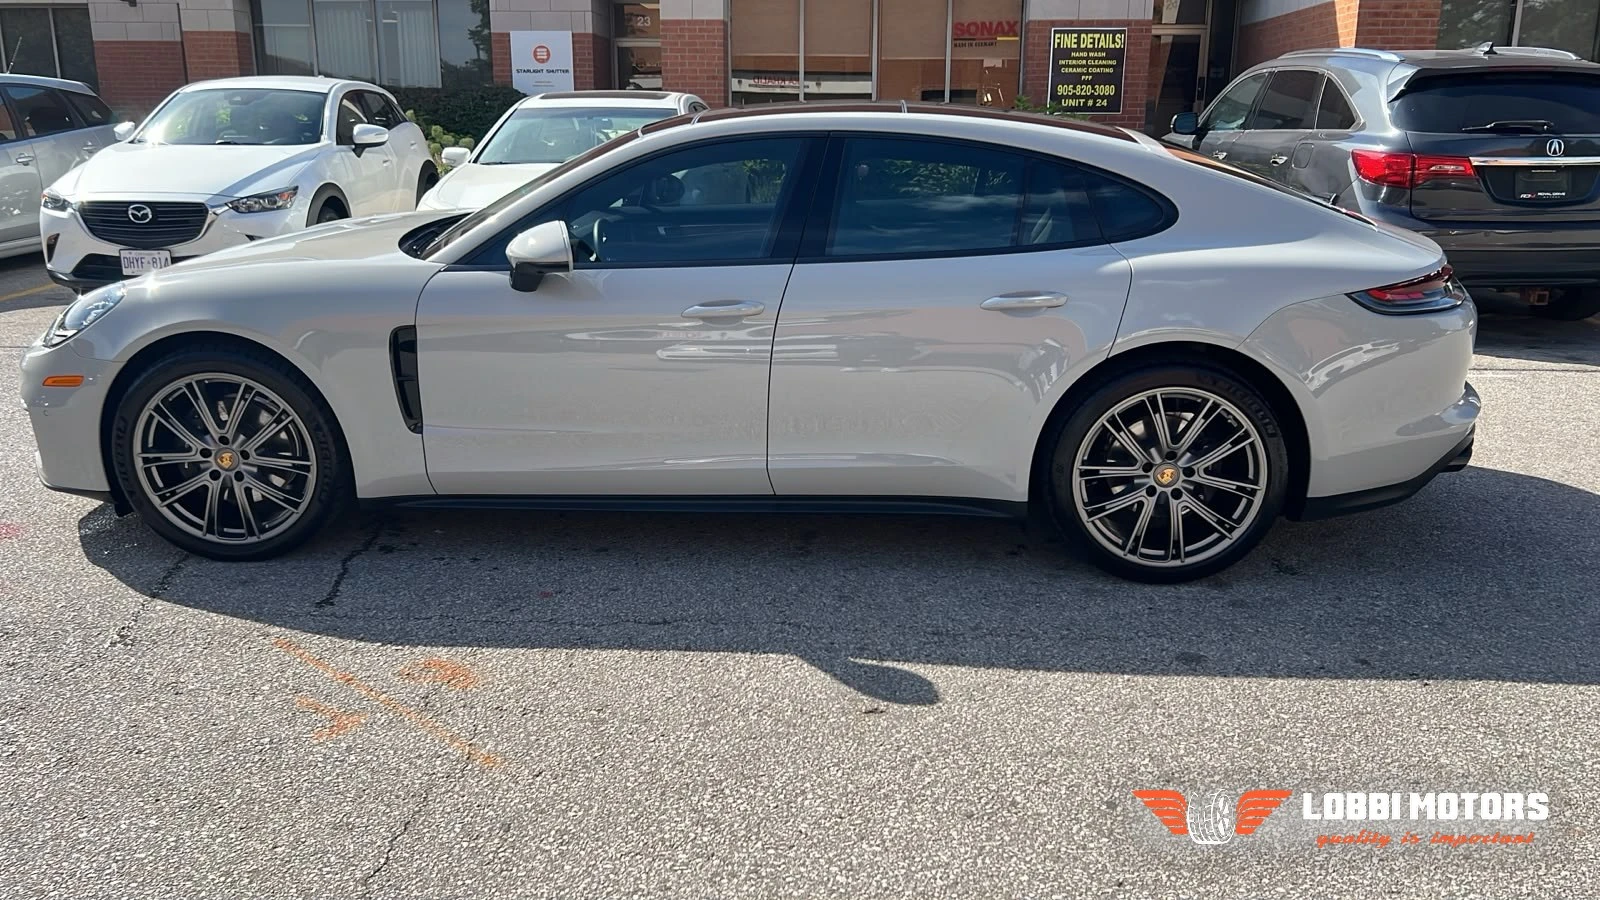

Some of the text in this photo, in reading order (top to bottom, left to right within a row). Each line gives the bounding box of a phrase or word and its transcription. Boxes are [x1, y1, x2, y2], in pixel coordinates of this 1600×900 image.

[637, 16, 651, 26] 23
[954, 20, 1018, 37] SONAX
[1055, 33, 1124, 48] FINE DETAILS!
[1057, 85, 1115, 95] 905-820-3080
[123, 256, 145, 269] DHYF
